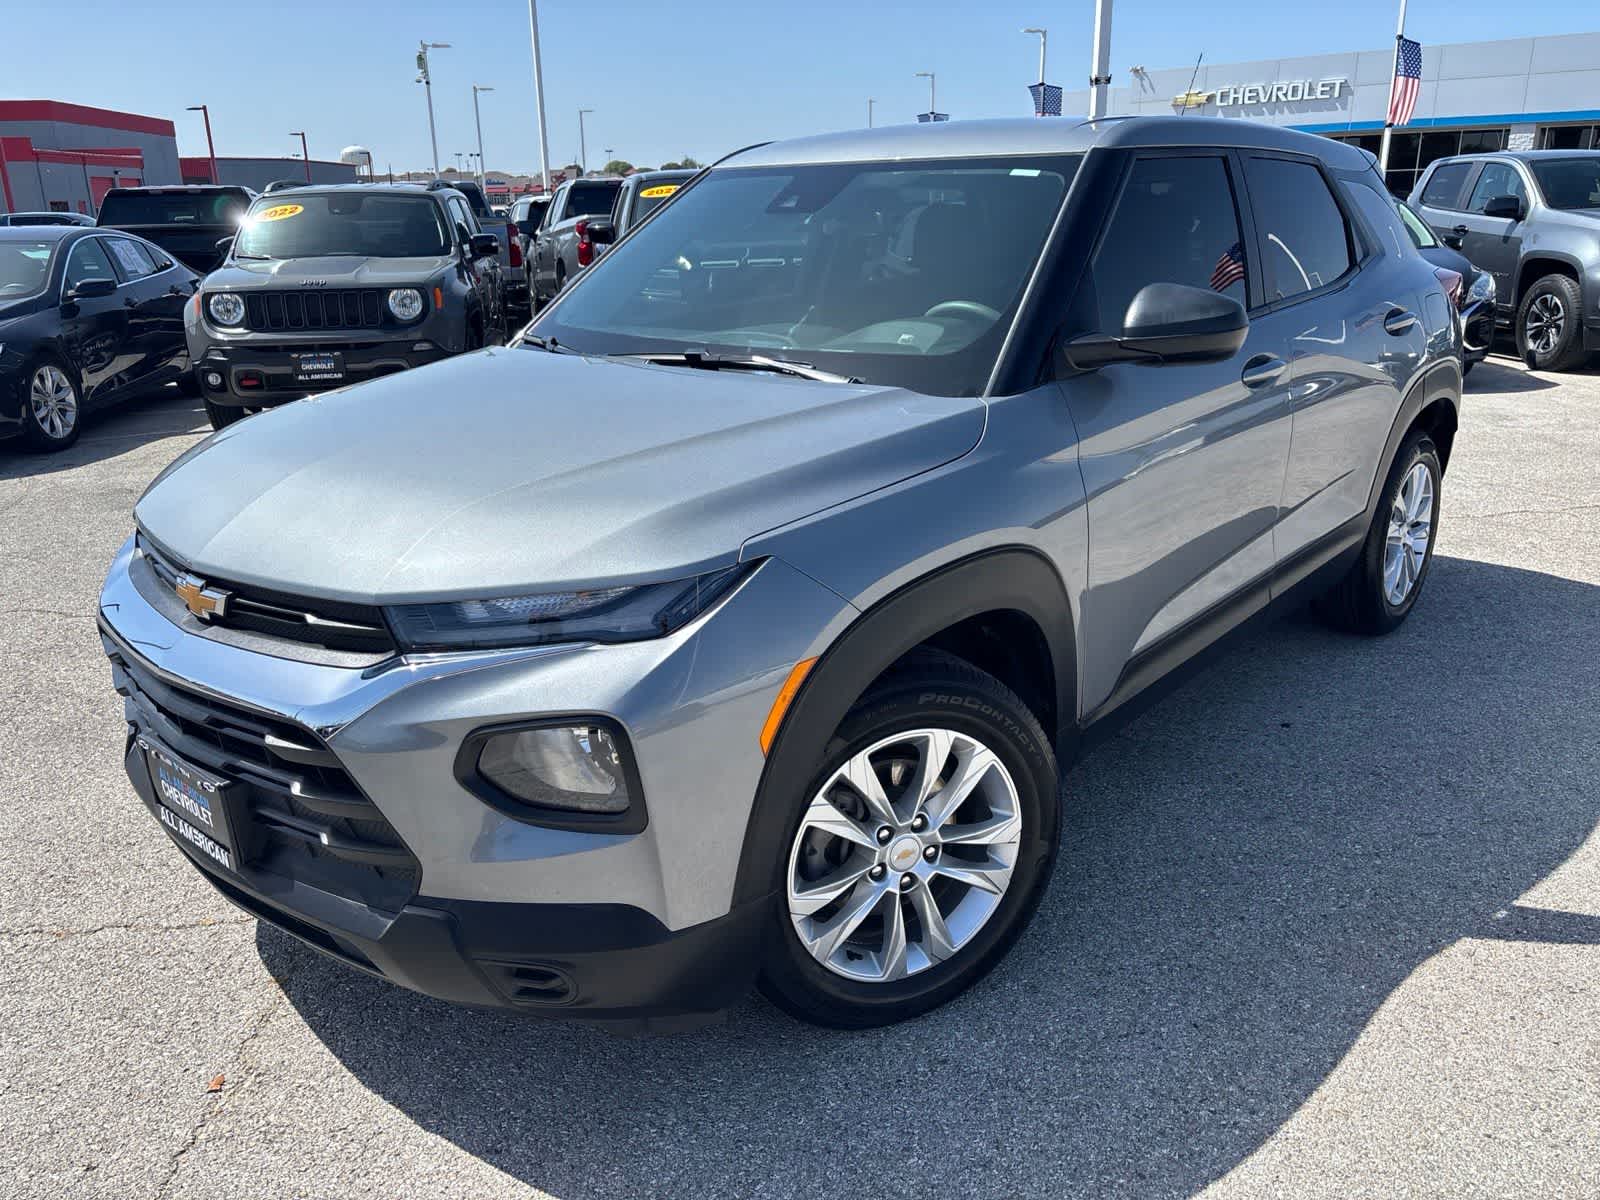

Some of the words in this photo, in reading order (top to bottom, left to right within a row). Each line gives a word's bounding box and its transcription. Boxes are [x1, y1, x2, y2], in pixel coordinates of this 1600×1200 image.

[1215, 75, 1348, 107] CHEVROLET
[161, 779, 213, 828] CHEVROLET
[161, 806, 178, 831] ALL
[179, 818, 230, 869] AMERICAN
